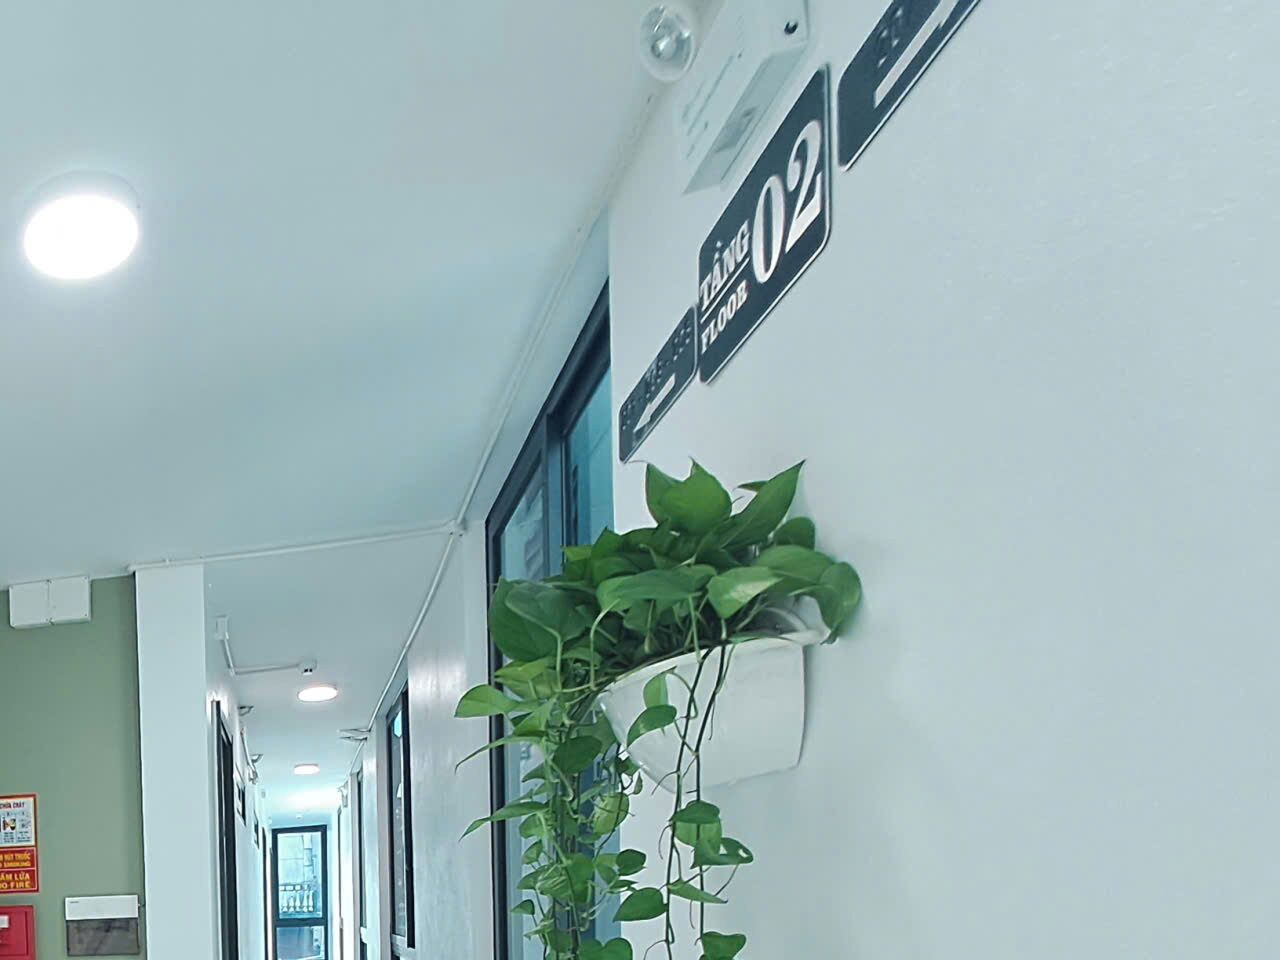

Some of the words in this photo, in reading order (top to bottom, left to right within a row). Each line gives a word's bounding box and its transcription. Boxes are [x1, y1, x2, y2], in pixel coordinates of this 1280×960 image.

[700, 219, 750, 311] TẦNG
[752, 120, 823, 284] 02
[10, 881, 31, 889] FIRE
